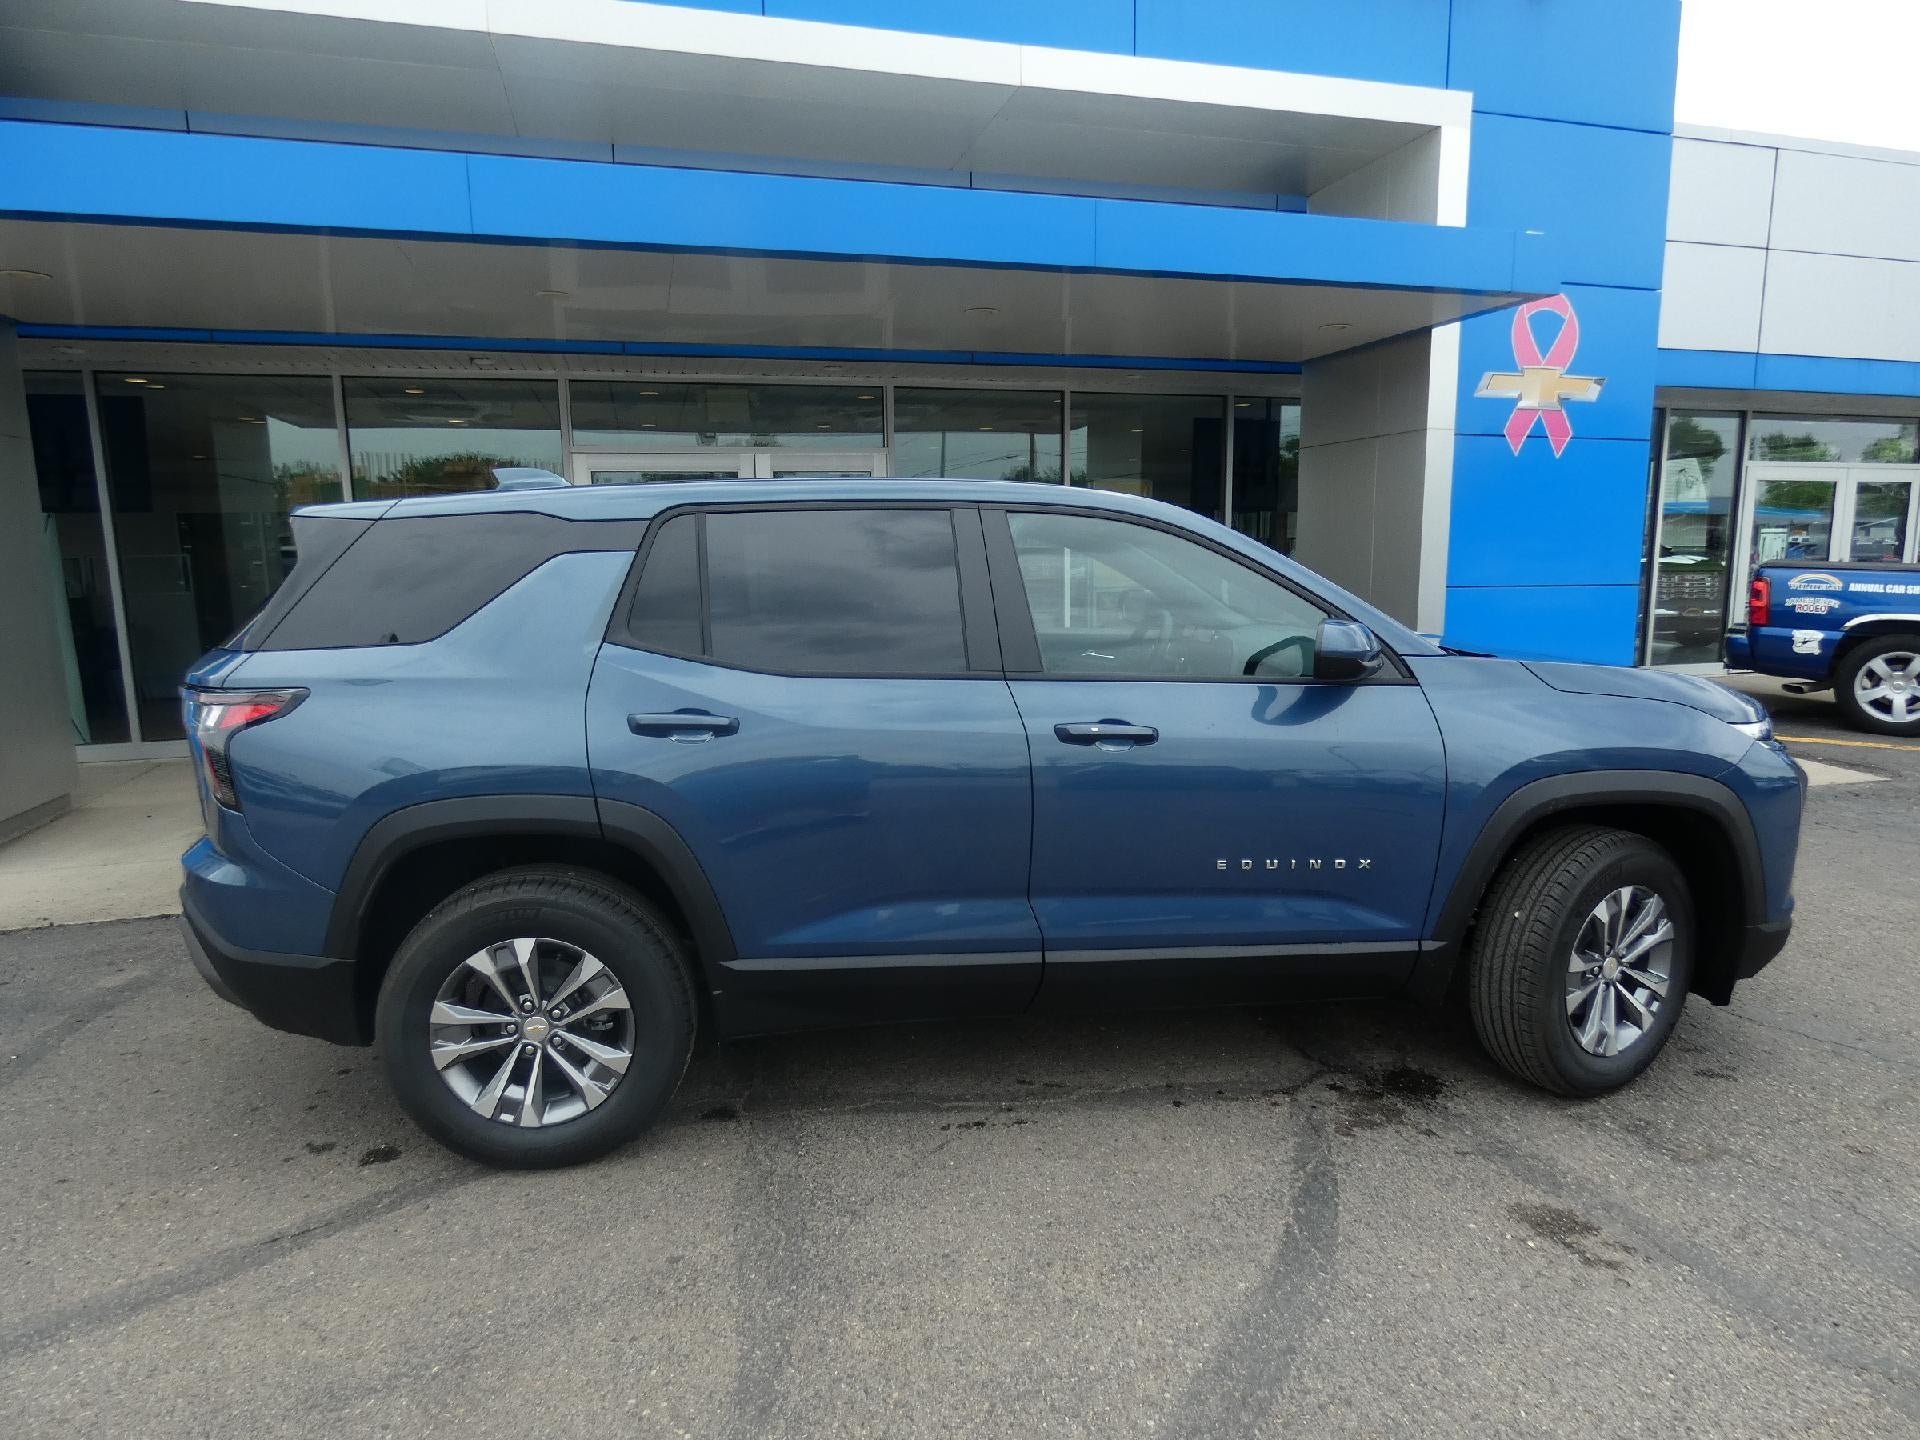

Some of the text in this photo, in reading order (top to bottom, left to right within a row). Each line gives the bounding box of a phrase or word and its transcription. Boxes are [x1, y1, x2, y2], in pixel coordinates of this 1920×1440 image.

[1848, 583, 1885, 592] ANNUAL
[1886, 584, 1905, 593] CAR
[1796, 603, 1827, 613] RODEO
[1216, 859, 1371, 870] EQUINOX
